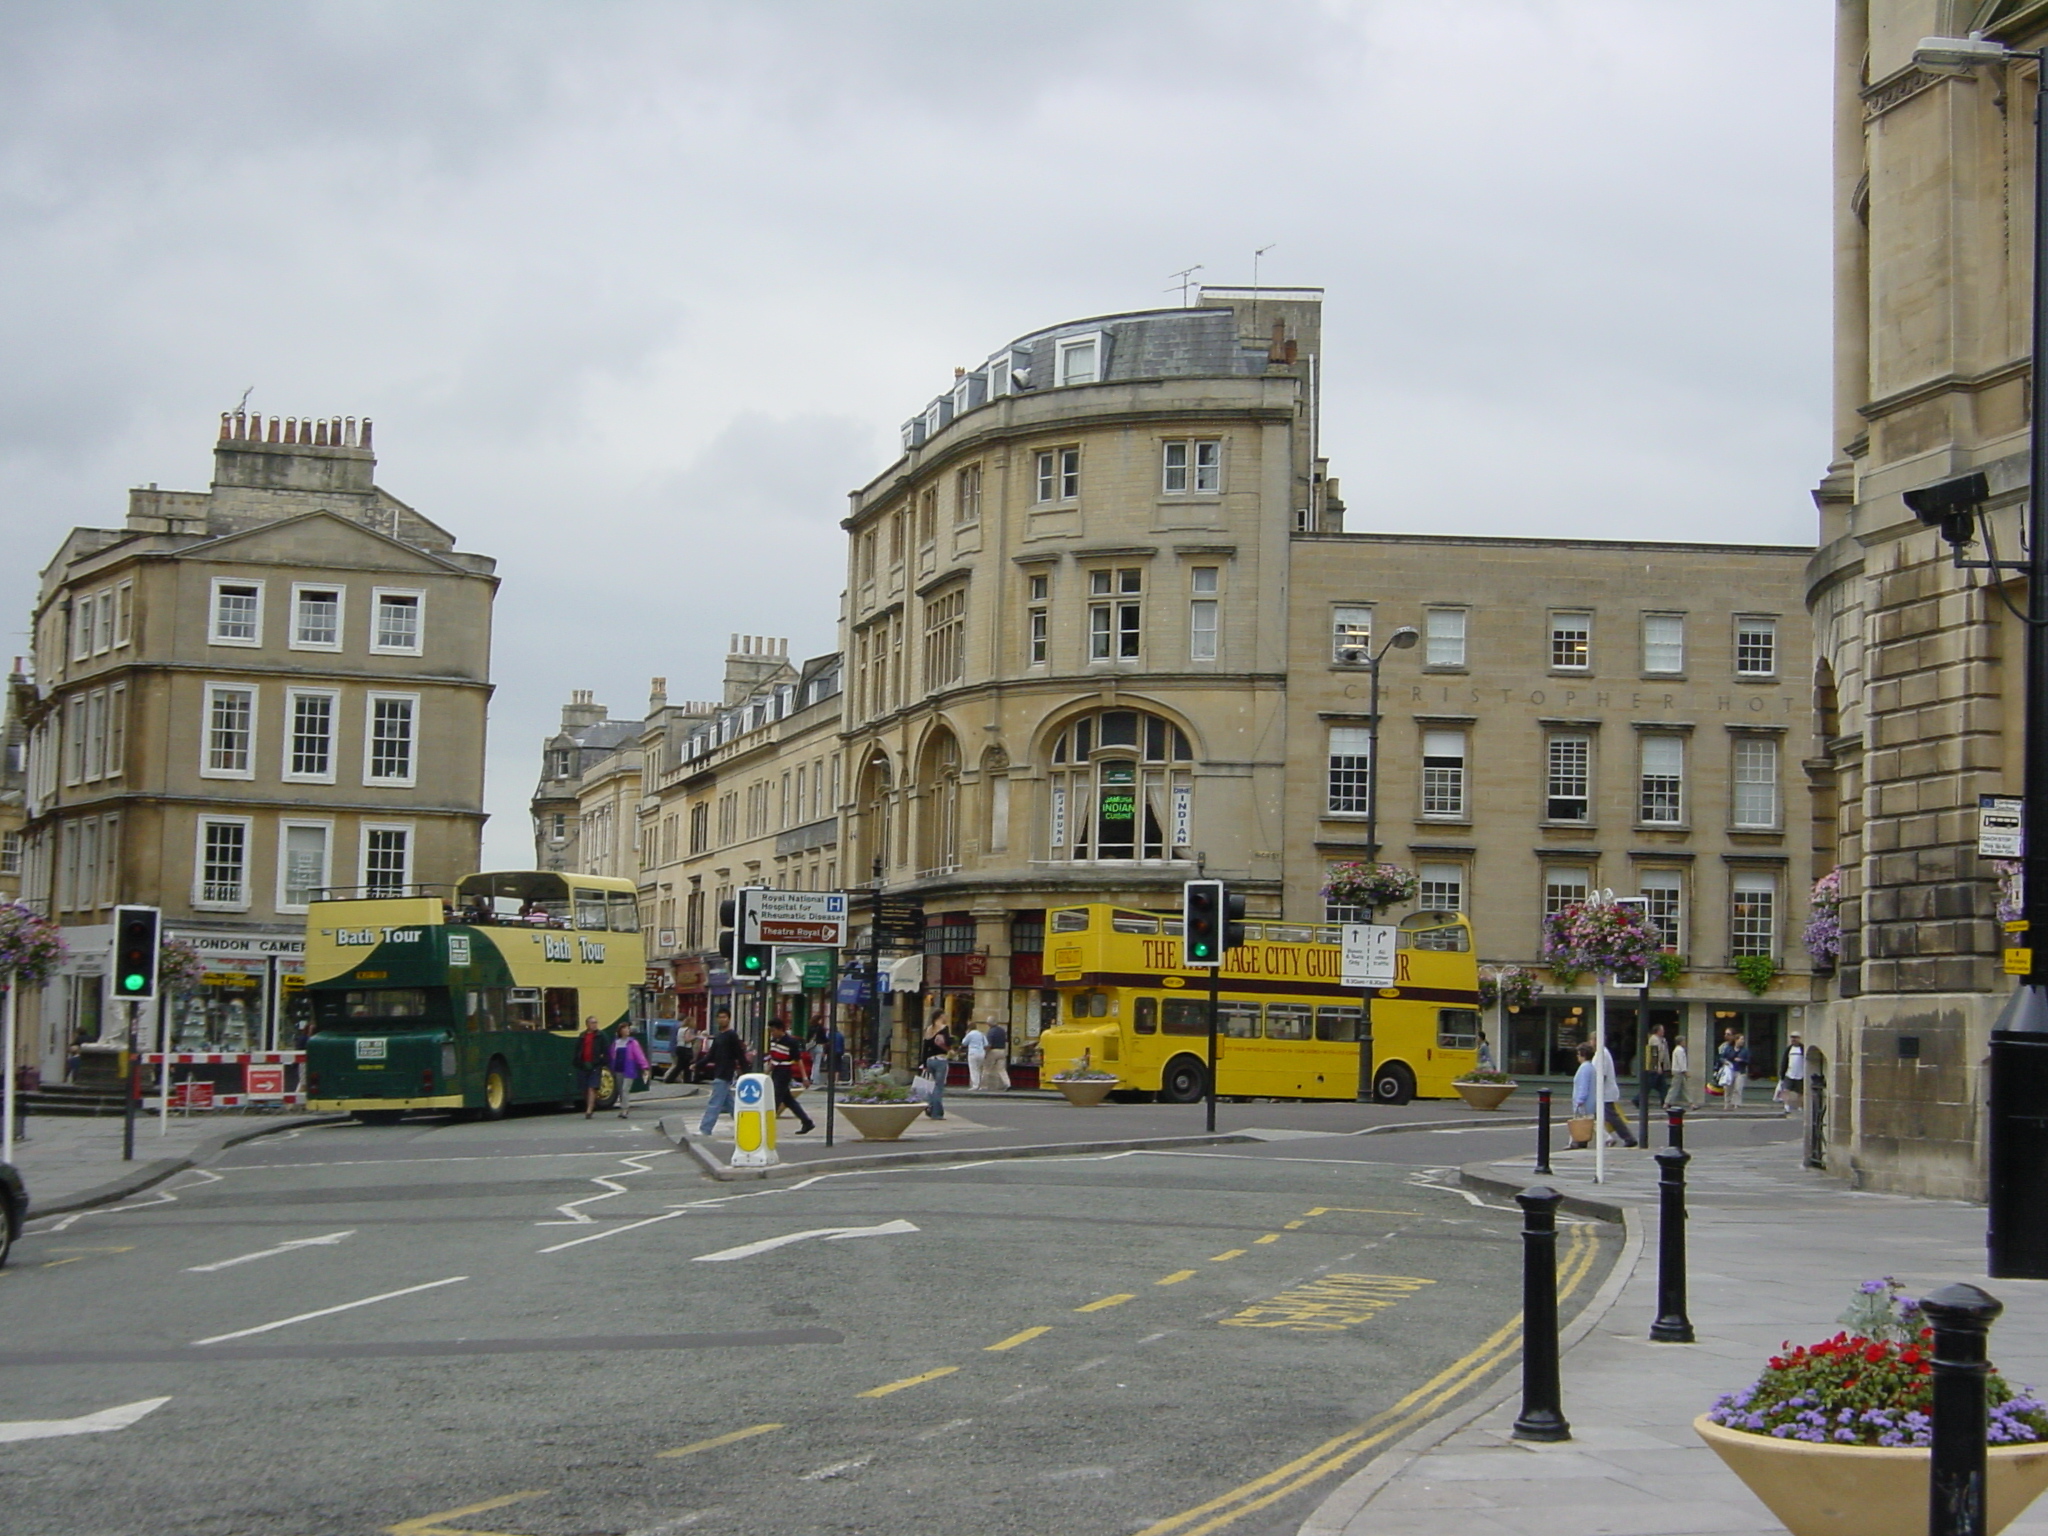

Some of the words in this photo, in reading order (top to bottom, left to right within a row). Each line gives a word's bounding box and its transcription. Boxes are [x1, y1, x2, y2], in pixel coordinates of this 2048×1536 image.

[1344, 685, 1674, 709] CHRISTOPHER
[1102, 803, 1135, 813] INDIAN
[1176, 795, 1187, 843] INDIAN
[761, 894, 786, 902] Royal
[788, 894, 824, 903] National
[761, 903, 797, 911] Hospital
[761, 911, 806, 919] Rheumatic
[808, 913, 845, 921] Diseases
[337, 928, 375, 946] Bath
[380, 927, 422, 943] Tour
[762, 926, 795, 935] Theatre
[797, 928, 820, 937] Royal
[192, 939, 249, 951] LONDON
[544, 935, 571, 962] Bath
[579, 936, 606, 963] Tour
[1142, 940, 1176, 969] THE
[1265, 946, 1301, 976] CITY
